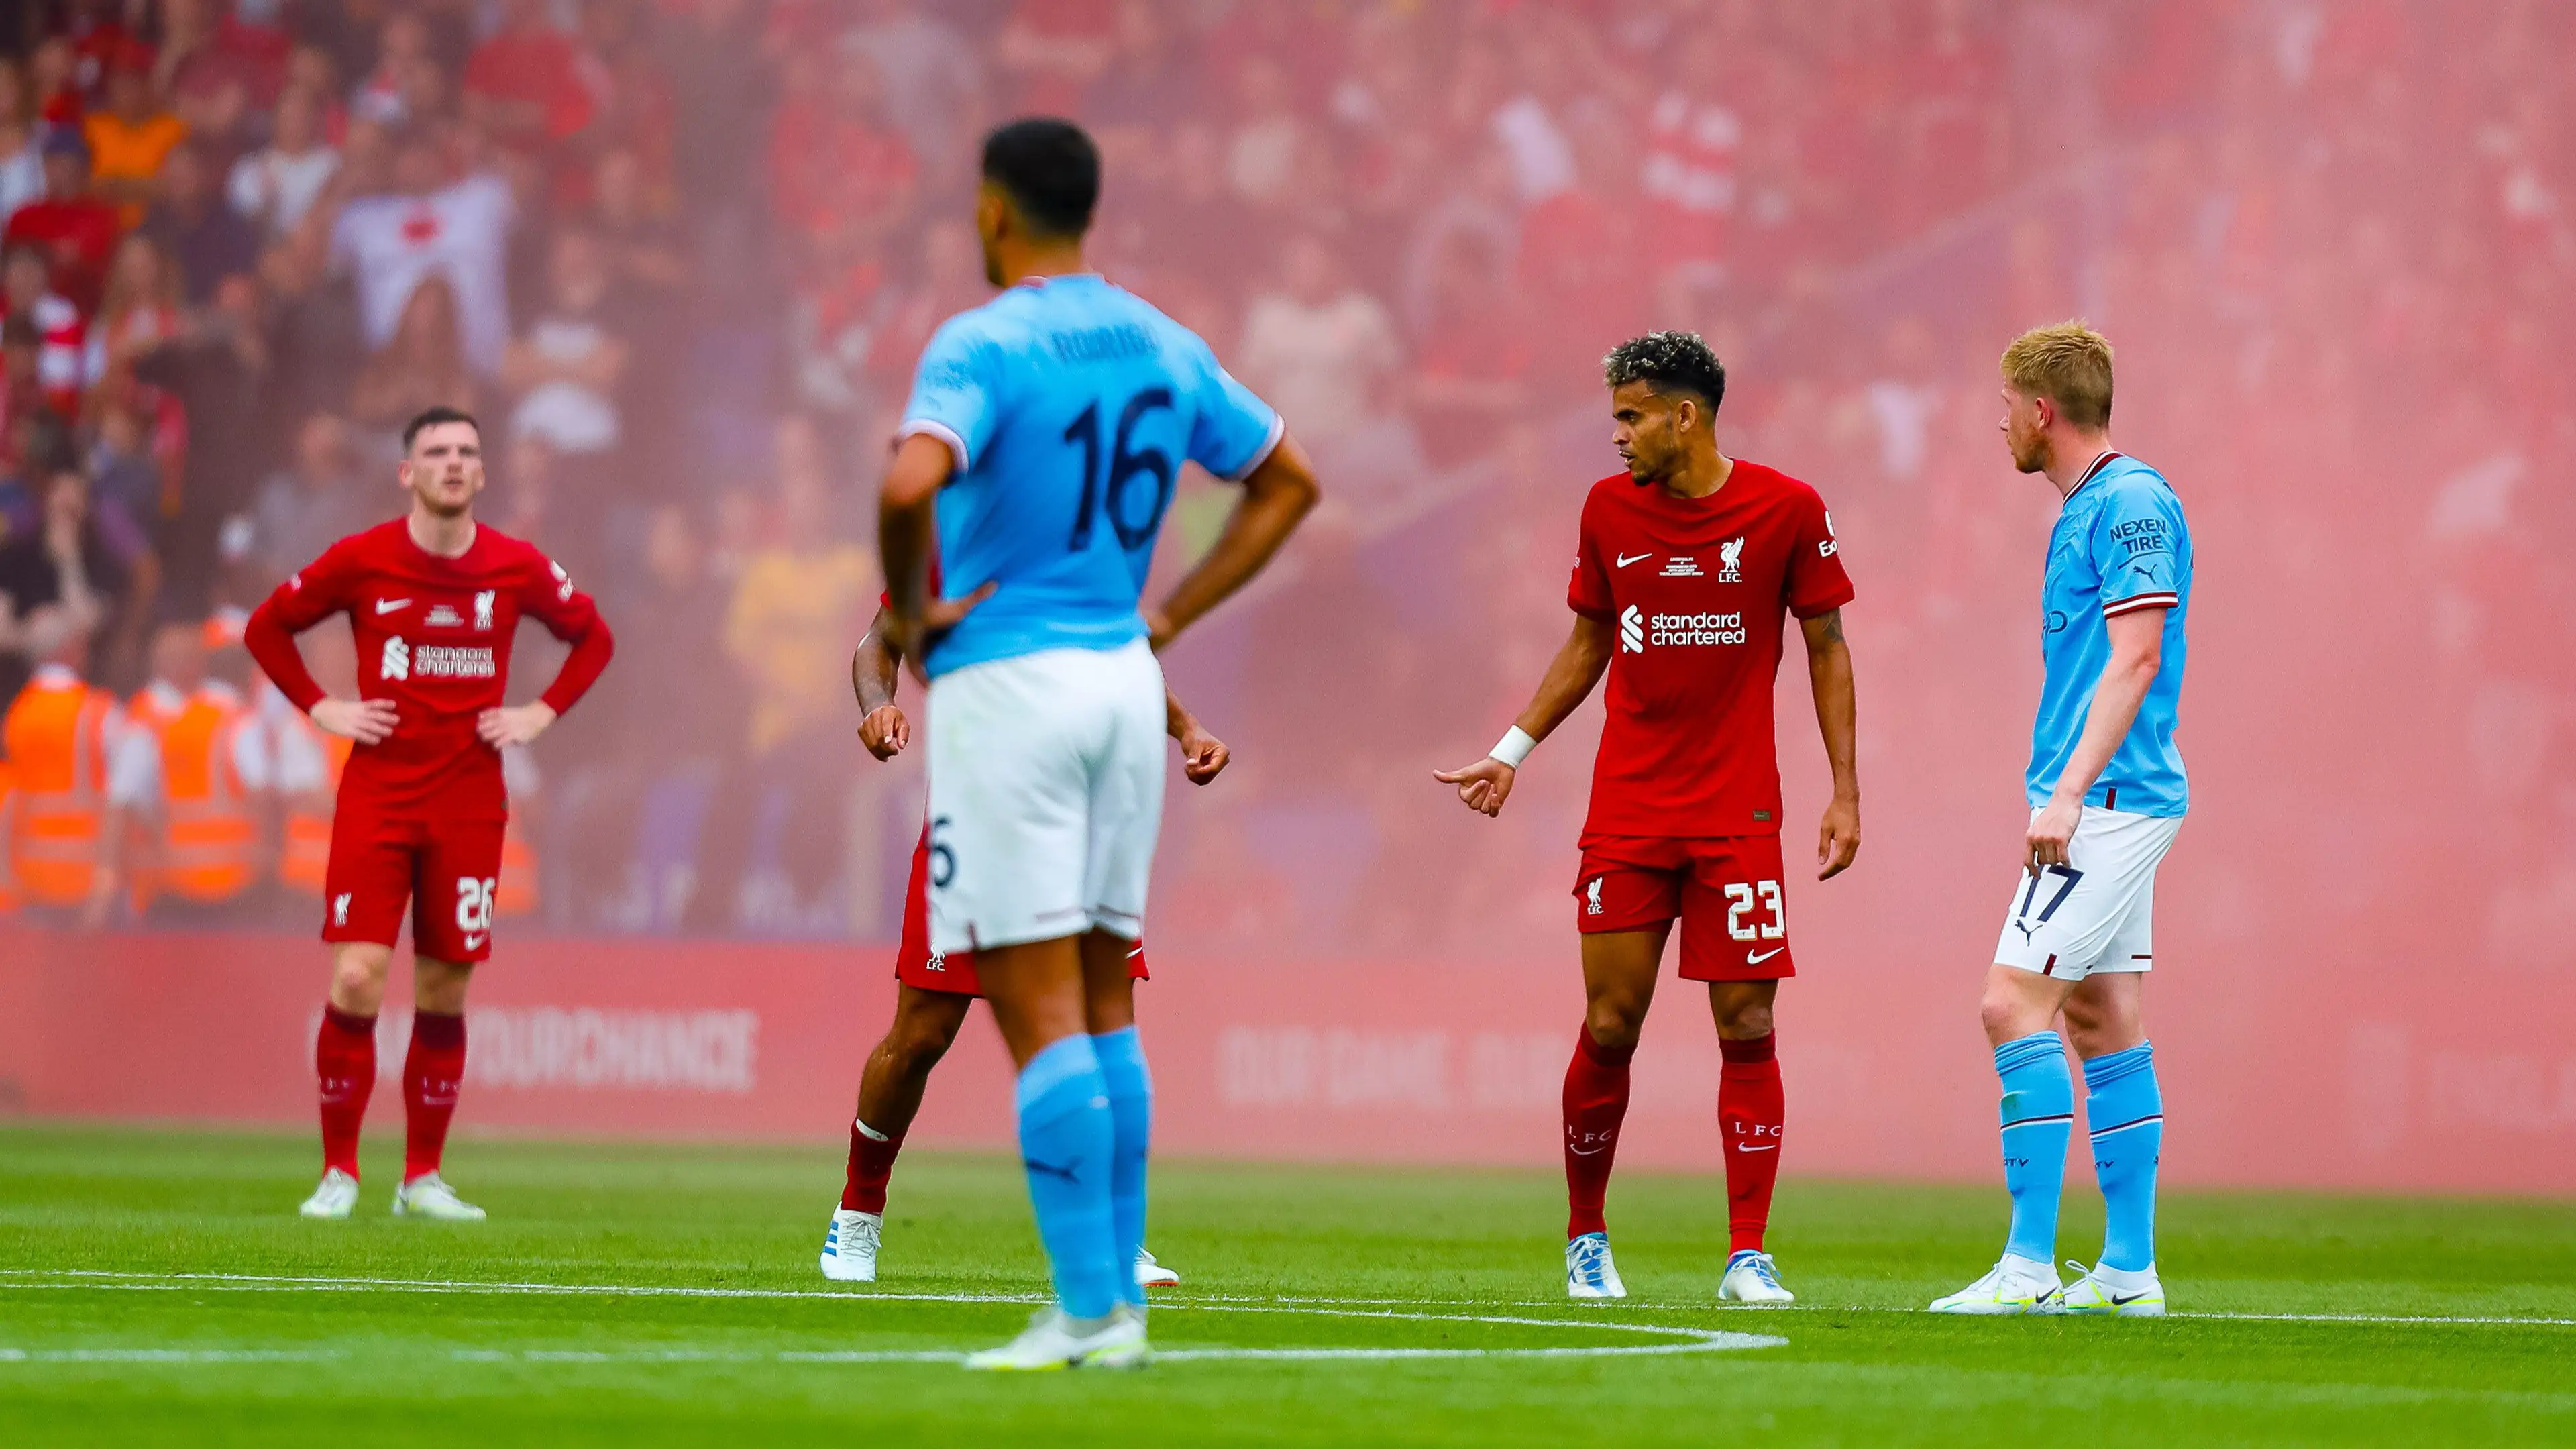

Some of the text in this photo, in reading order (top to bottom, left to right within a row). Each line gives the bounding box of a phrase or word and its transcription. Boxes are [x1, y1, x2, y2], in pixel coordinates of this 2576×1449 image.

[1064, 387, 1174, 553] 16
[2110, 518, 2167, 542] NEXEN
[2122, 535, 2163, 555] TIRE
[1651, 611, 1741, 630] standard
[1651, 627, 1746, 645] chartered
[457, 876, 496, 932] 26
[1724, 879, 1786, 941] 23
[2019, 864, 2084, 923] 17
